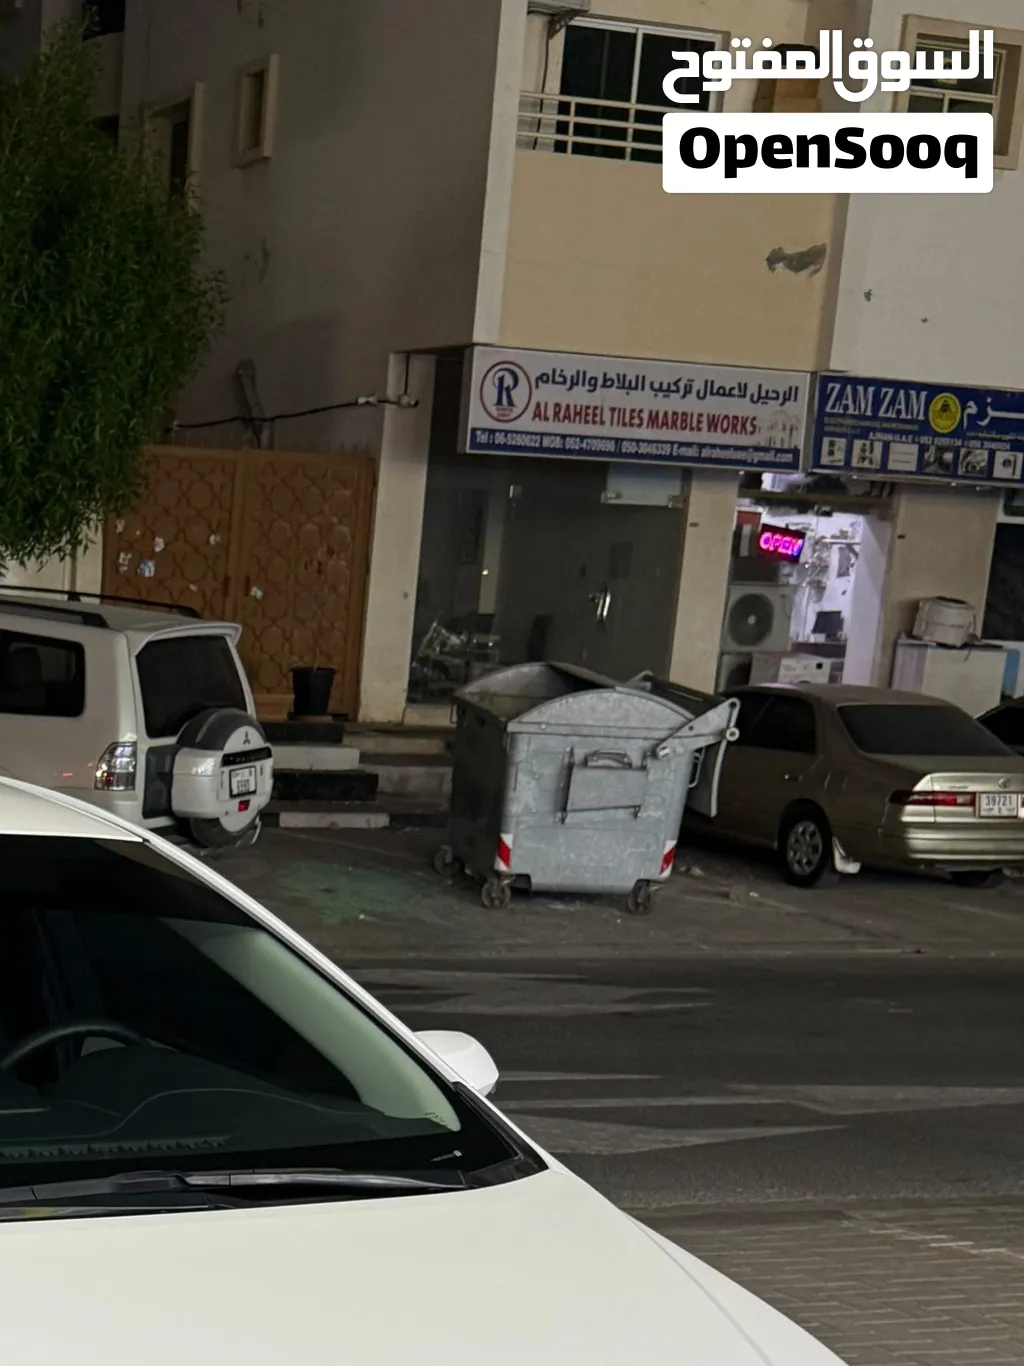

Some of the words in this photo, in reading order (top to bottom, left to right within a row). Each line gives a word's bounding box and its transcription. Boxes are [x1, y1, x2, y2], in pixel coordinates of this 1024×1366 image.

[535, 368, 599, 393] والرخام
[600, 372, 646, 397] البلاط
[649, 377, 695, 400] تركيب
[696, 379, 748, 401] لاعمال
[750, 383, 799, 407] الرحيل
[825, 382, 875, 417] ZAM
[878, 387, 928, 421] ZAM
[532, 401, 550, 421] AL
[552, 402, 606, 426] RAHEEL
[608, 406, 644, 428] TILES
[646, 408, 704, 432] MARBLE
[706, 412, 757, 435] WORKS
[759, 532, 804, 556] OPEN
